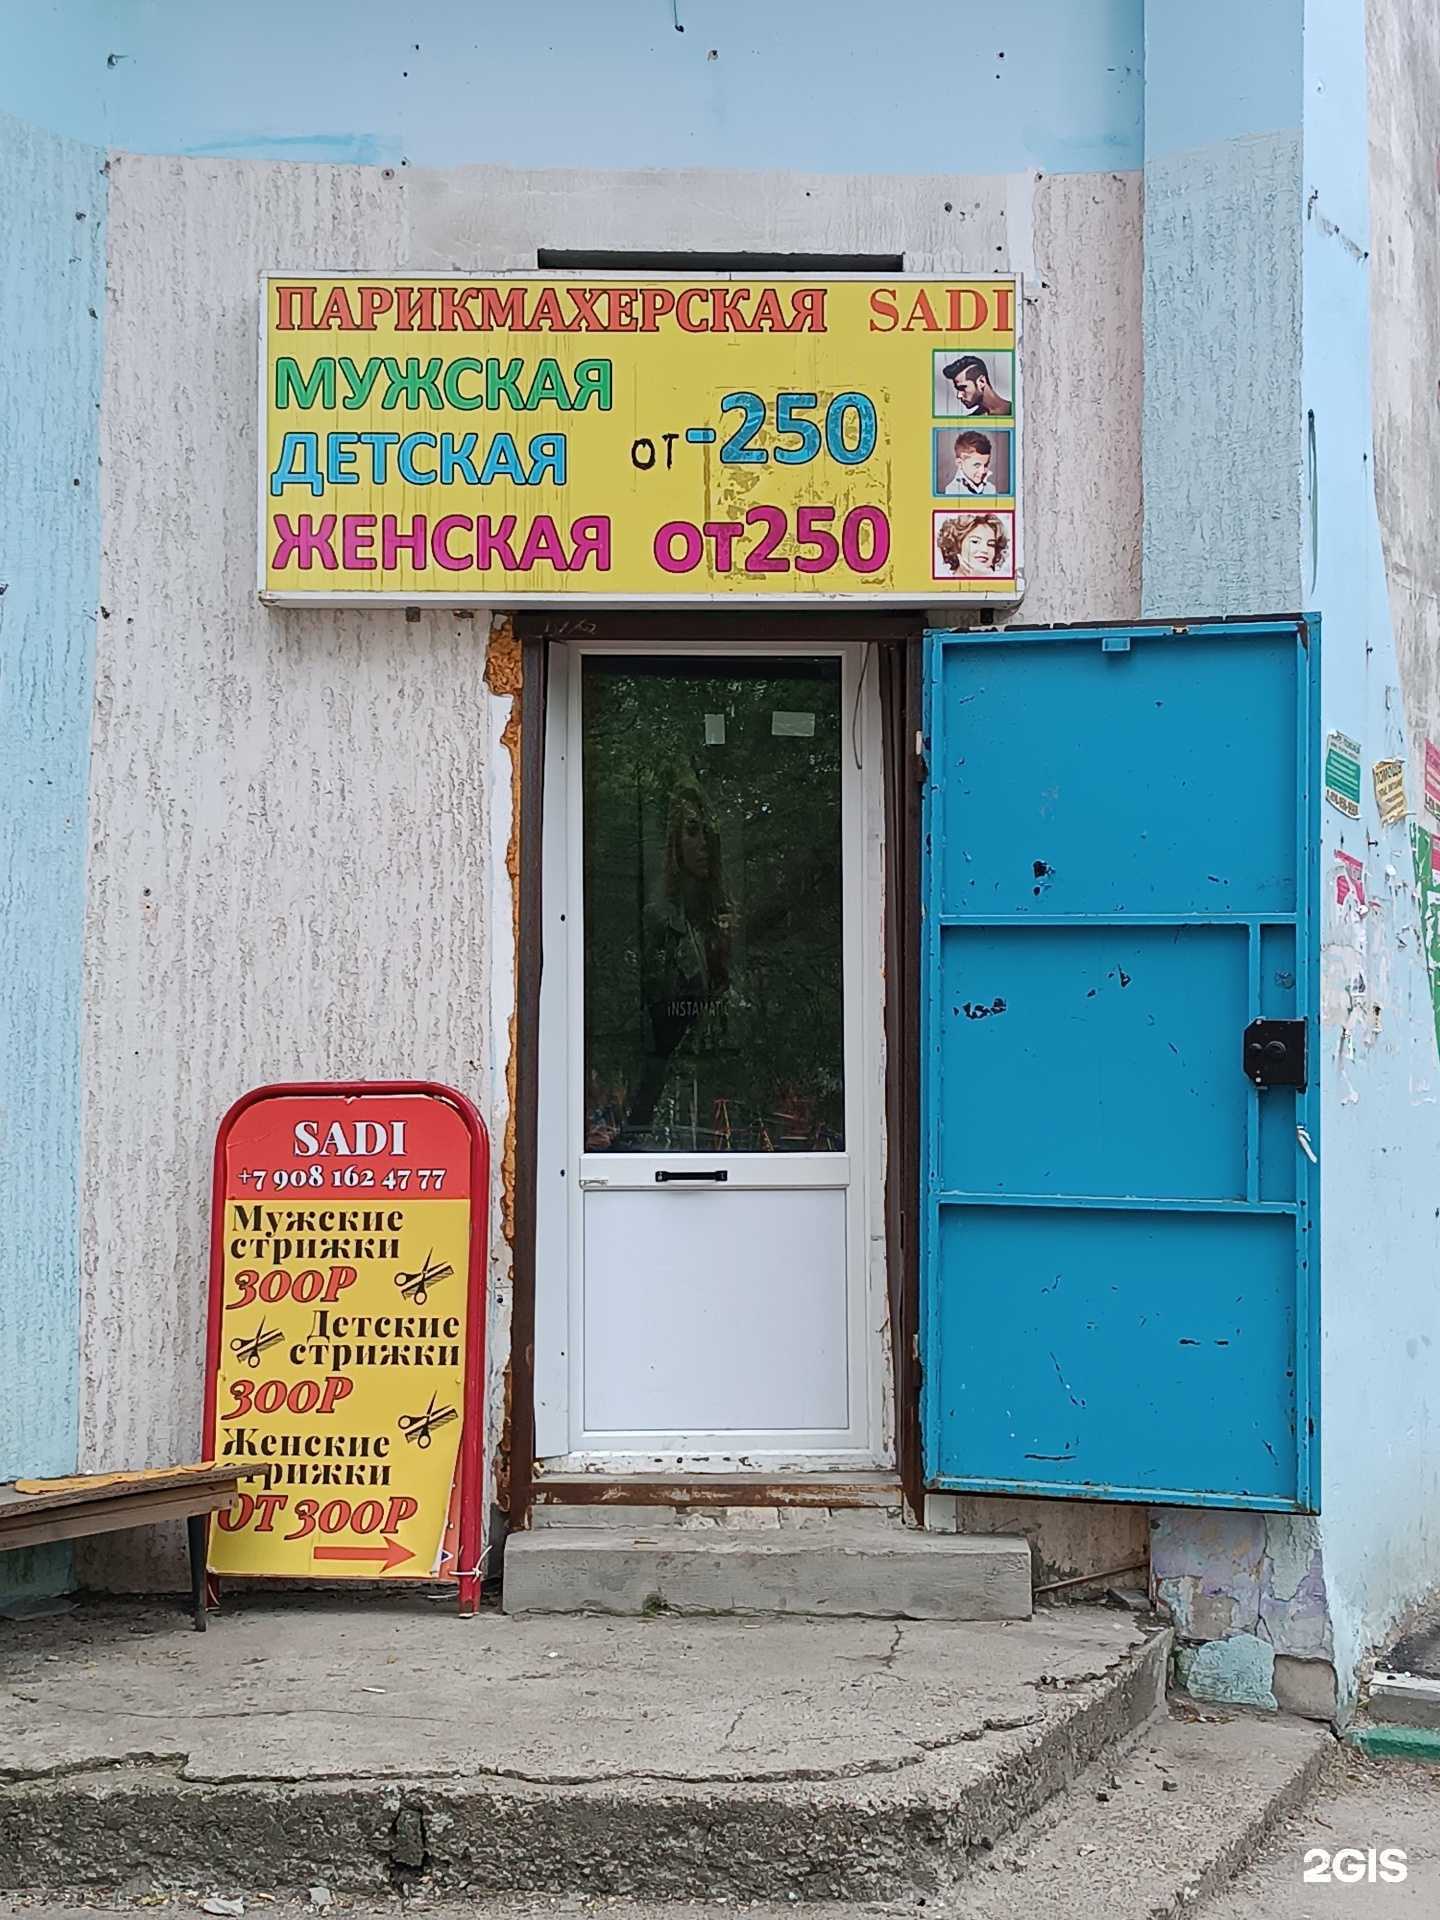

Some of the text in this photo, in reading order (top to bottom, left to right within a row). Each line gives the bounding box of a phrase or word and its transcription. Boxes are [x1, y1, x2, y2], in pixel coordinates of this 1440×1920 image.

[275, 286, 1014, 333] ПАРИКМАХЕРСКАЯ SADI
[275, 357, 613, 411] МУЖСКАЯ
[270, 432, 567, 496] ДЕТСКАЯ
[271, 514, 612, 572] ЖЕНСКАЯ
[293, 1120, 407, 1157] SADI
[238, 1164, 447, 1191] +7 908 162 47 77
[231, 1204, 404, 1238] Мужские
[230, 1237, 399, 1265] стрижки
[307, 1310, 460, 1345] Детские
[289, 1342, 460, 1372] стрижки
[222, 1428, 391, 1458] Женские
[223, 1462, 392, 1490] рижки
[217, 1493, 289, 1532] ОТ
